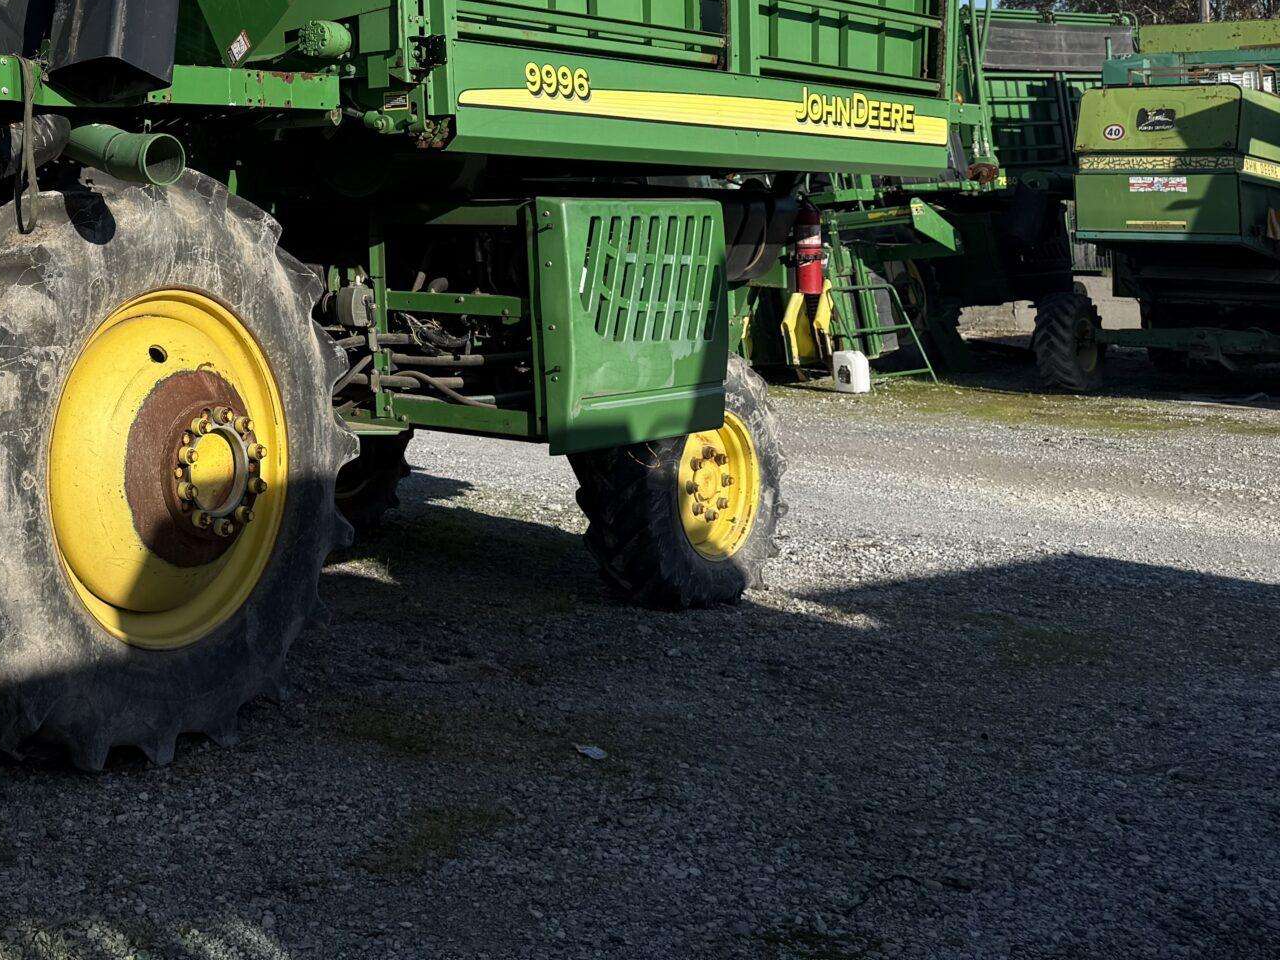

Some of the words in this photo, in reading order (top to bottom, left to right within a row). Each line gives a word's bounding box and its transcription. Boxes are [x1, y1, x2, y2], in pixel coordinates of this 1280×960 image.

[525, 61, 591, 101] 9996
[795, 86, 851, 127] JOHN
[851, 92, 915, 132] DEERE
[1106, 127, 1121, 137] 40
